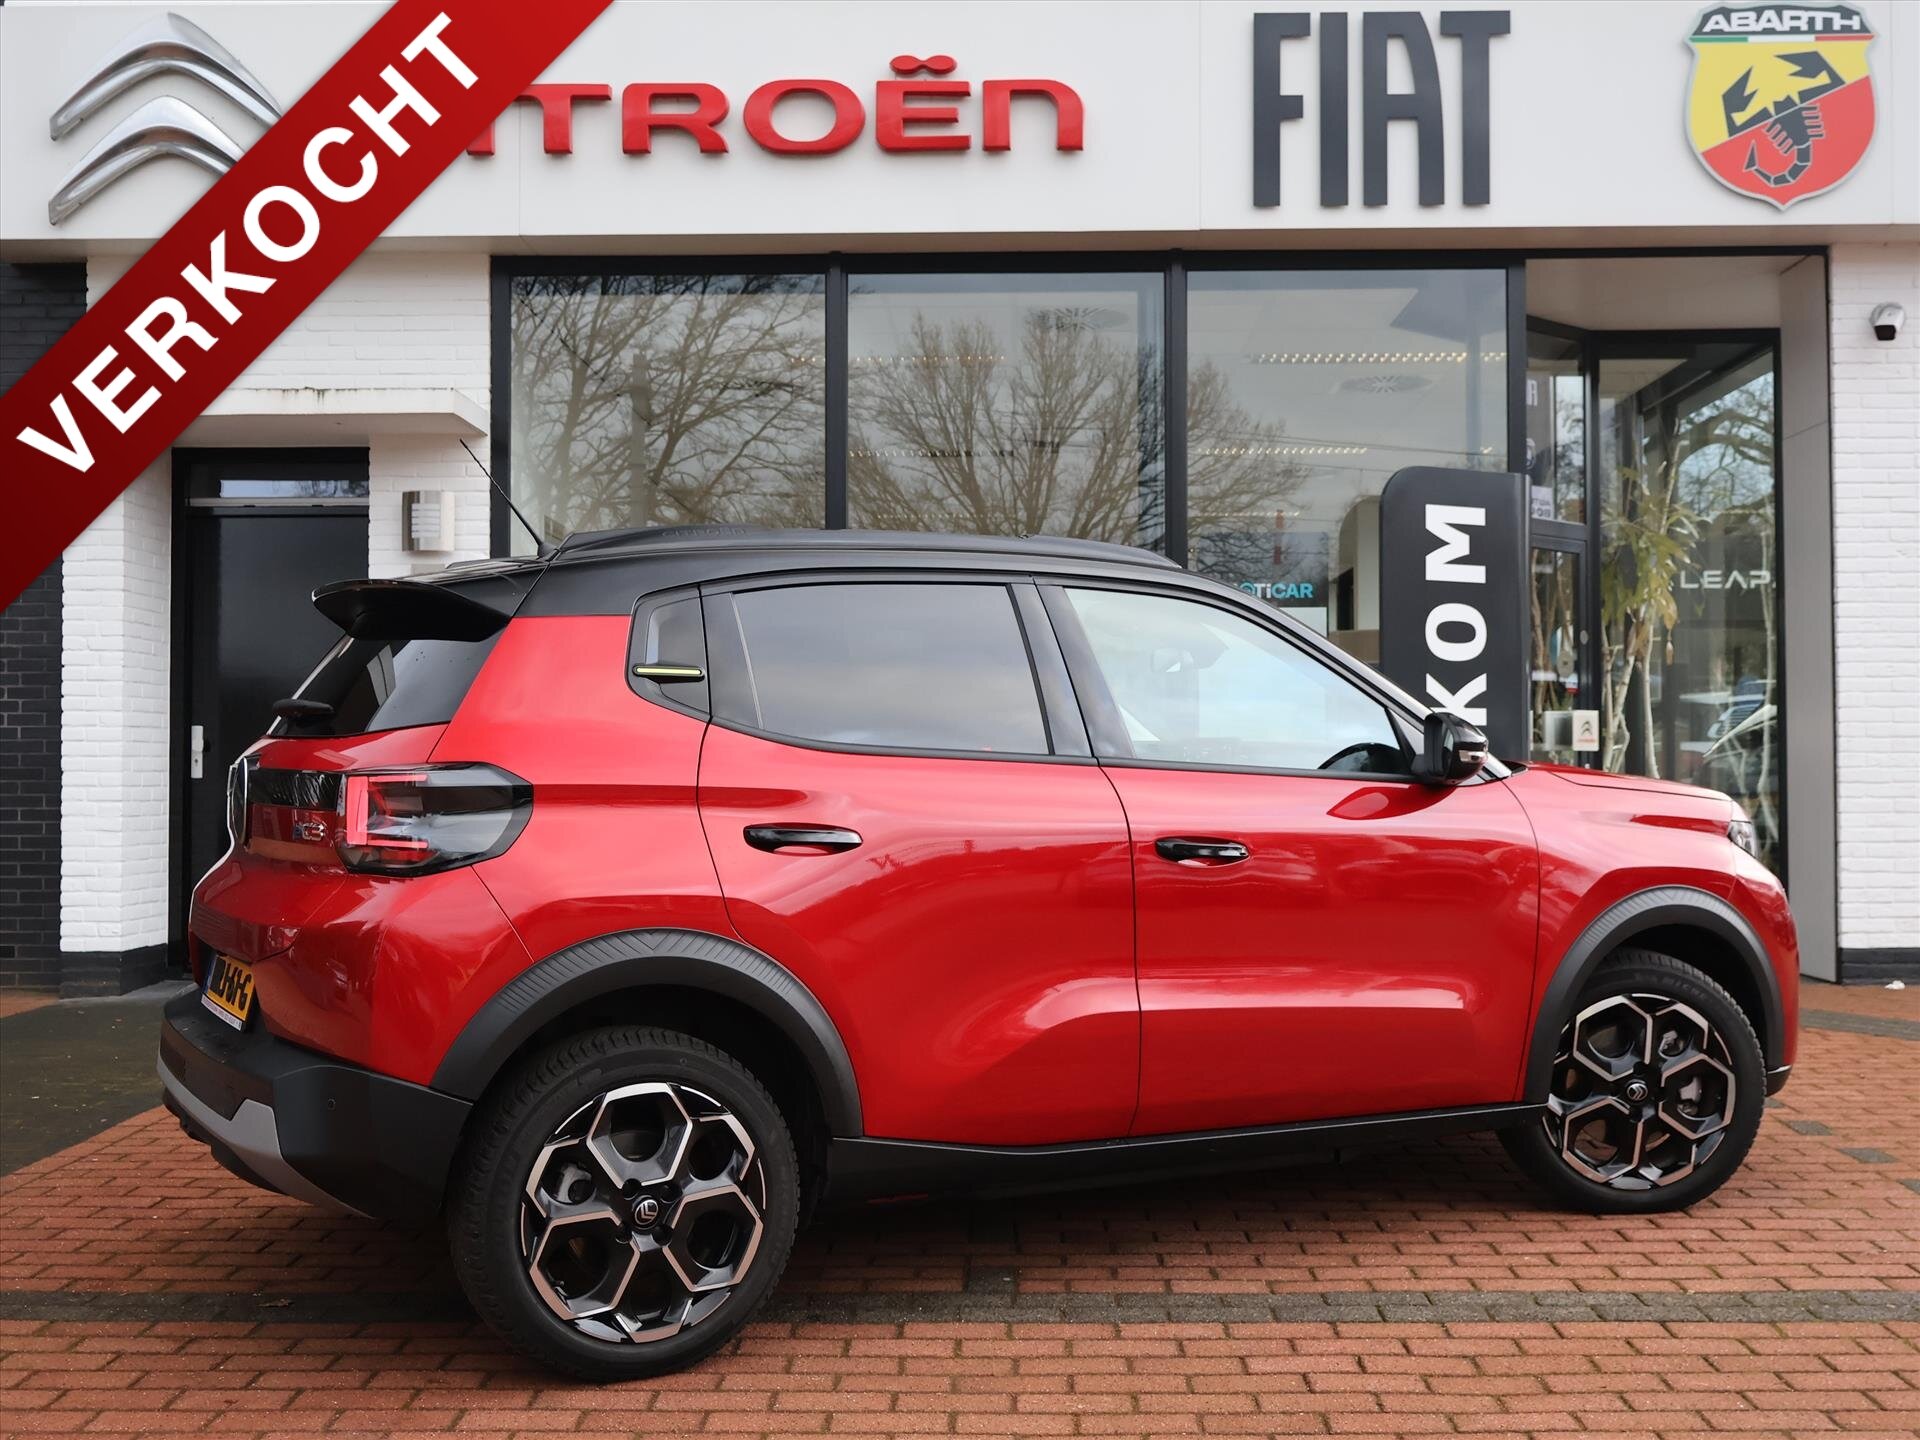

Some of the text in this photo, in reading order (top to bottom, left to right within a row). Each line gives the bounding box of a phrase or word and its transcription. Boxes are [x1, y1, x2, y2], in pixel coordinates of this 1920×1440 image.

[1701, 9, 1862, 33] ABARTH
[466, 54, 1085, 157] TROËN
[1253, 10, 1512, 208] FIAT
[1233, 582, 1314, 600] OTiCAR
[1680, 569, 1777, 589] LEAP
[1424, 503, 1488, 727] KOM
